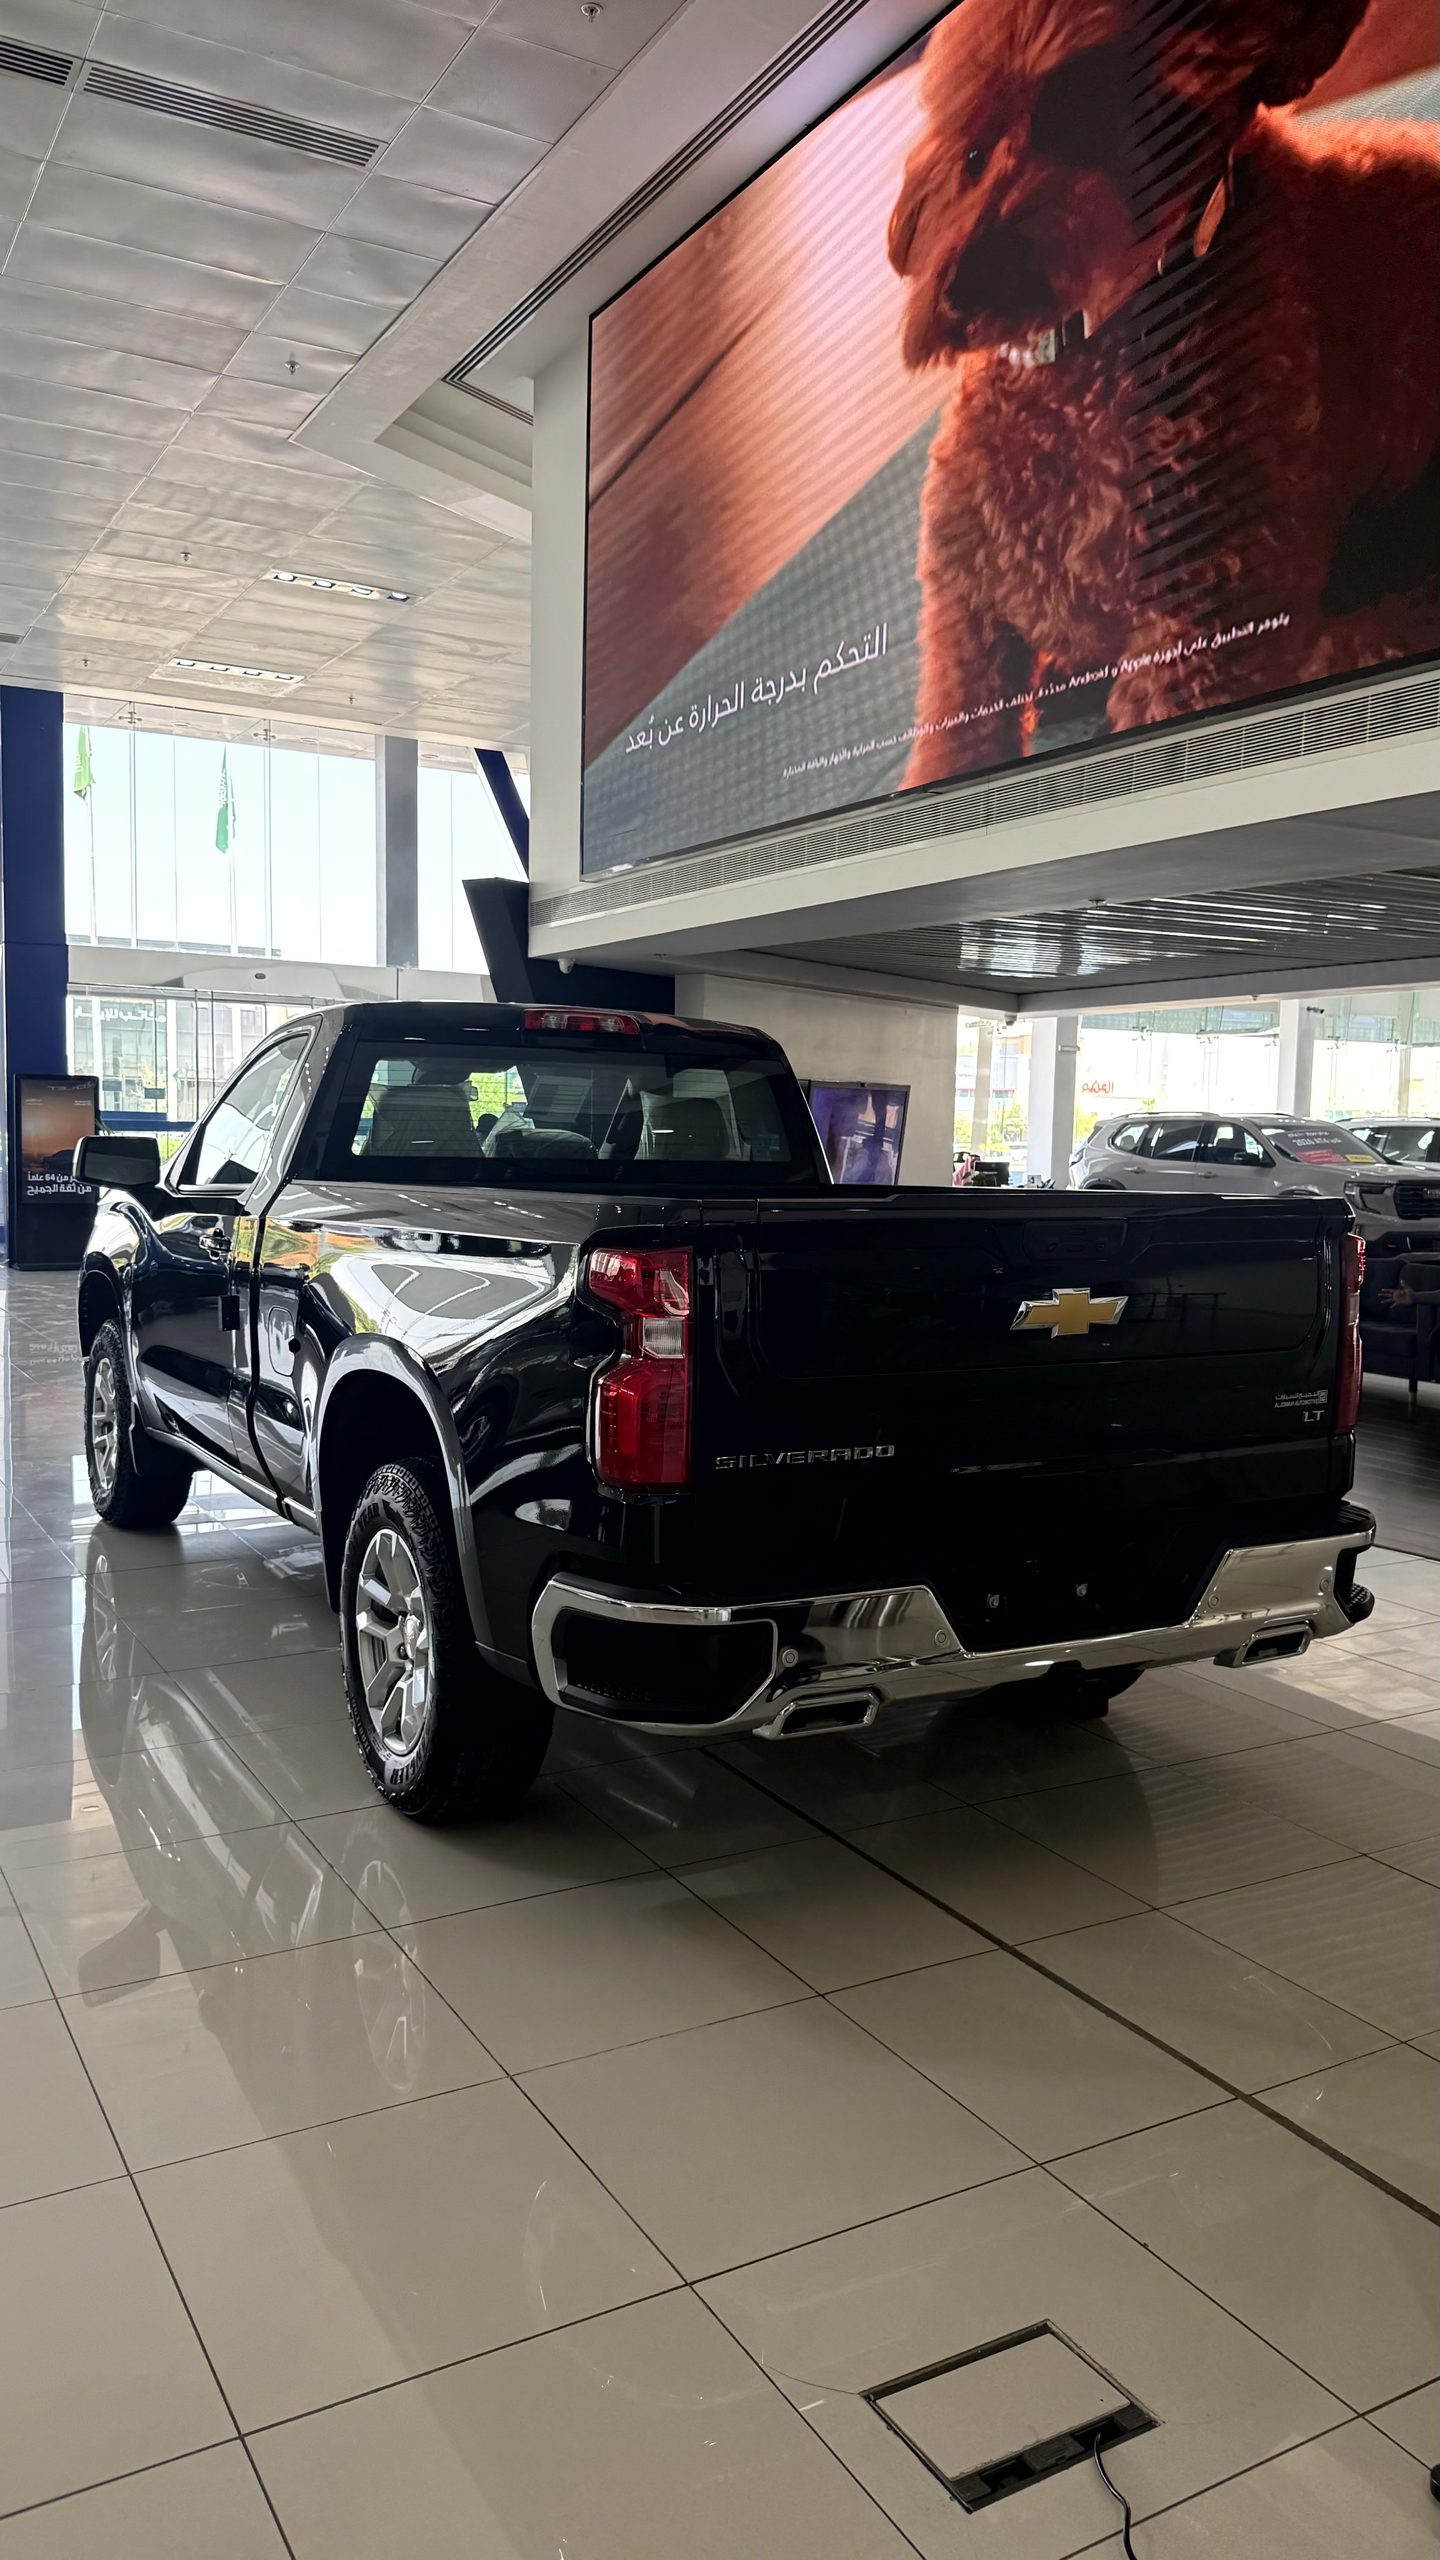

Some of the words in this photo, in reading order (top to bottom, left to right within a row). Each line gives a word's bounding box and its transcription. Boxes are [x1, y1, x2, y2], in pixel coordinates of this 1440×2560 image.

[813, 622, 888, 693] التحكم
[1118, 653, 1151, 676] Apple
[751, 667, 807, 706] بدرجة
[1068, 664, 1109, 688] Android
[689, 681, 744, 733] الحرارة
[658, 714, 683, 746] عن
[1303, 1410, 1325, 1422] LT
[715, 1444, 896, 1470] SILVERADO
